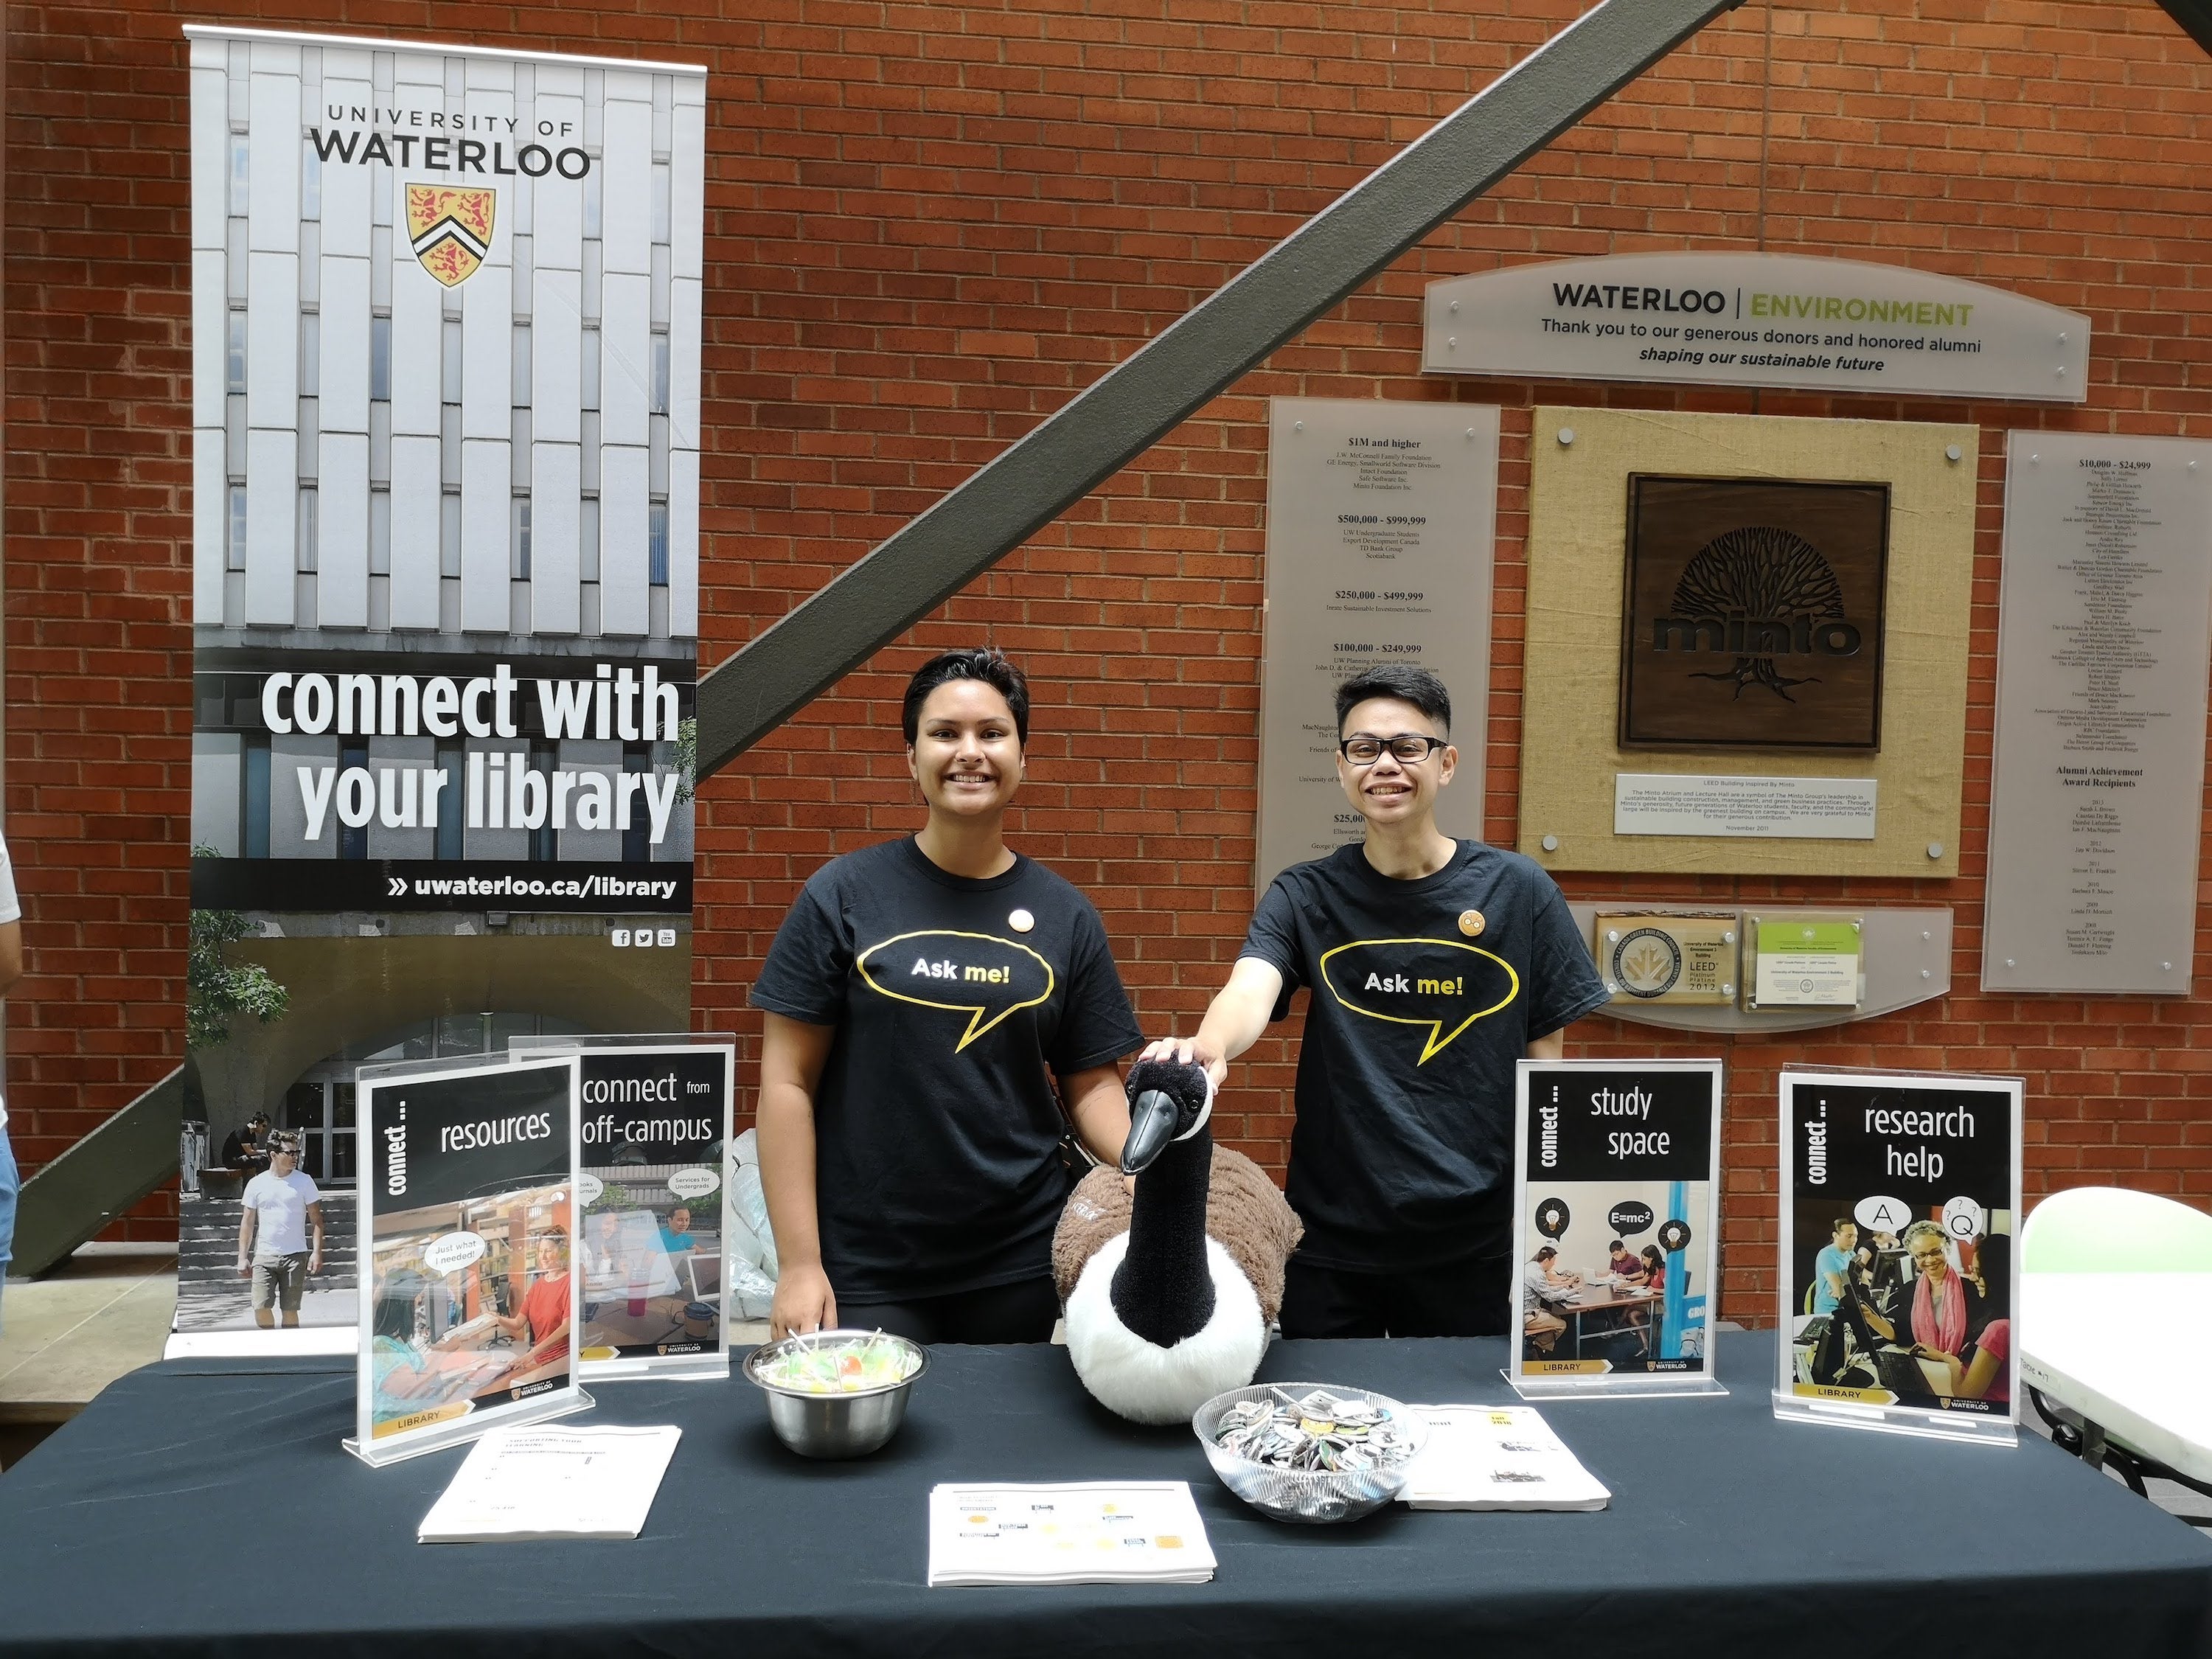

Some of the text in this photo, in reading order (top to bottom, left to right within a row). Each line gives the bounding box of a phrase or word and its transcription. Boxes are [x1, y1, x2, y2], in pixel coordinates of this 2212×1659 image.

[328, 105, 573, 137] UNIVERSITY OF
[310, 128, 590, 180] WATERLOO
[1552, 283, 1974, 327] WATERLOO ENVIRONMENT
[1541, 318, 1981, 352] Thank you to our generous donors and honored alumni
[1639, 348, 1885, 371] shaping our sustainable future
[1349, 437, 1421, 450] $1M and higher
[2079, 459, 2111, 468] $10,000
[2119, 461, 2151, 470] $24,999
[1338, 515, 1377, 524] $500,000
[1386, 516, 1426, 525] $999,999
[1335, 591, 1375, 600] $250,000
[1383, 591, 1424, 601] $499,999
[1653, 610, 1861, 655] minto
[1333, 643, 1374, 653] $100,000
[1382, 644, 1422, 653] $249,999
[262, 664, 679, 742] connect with
[2056, 767, 2143, 776] Alumni Achievement
[2062, 779, 2136, 788] Award Recipients
[297, 751, 678, 844] your library
[1334, 814, 1366, 824] $25,00
[414, 875, 677, 900] uwaterloo.ca/library
[911, 958, 1010, 984] Ask me!
[1364, 972, 1463, 995] Ask me!
[582, 1073, 710, 1104] connect from
[1590, 1086, 1652, 1120] study
[441, 1112, 552, 1153] resources
[582, 1114, 712, 1145] off-campus
[1865, 1106, 1975, 1138] research
[1608, 1131, 1670, 1160] space
[1887, 1144, 1944, 1183] help
[1873, 1203, 1893, 1225] A
[1951, 1214, 1973, 1236] Q
[436, 1240, 476, 1254] Just what
[441, 1251, 475, 1264] needed!
[1543, 1363, 1582, 1371] LIBRARY
[521, 1382, 553, 1396] WATERLOO
[1818, 1387, 1861, 1399] LIBRARY
[1951, 1402, 1989, 1411] WATERLOO
[398, 1411, 440, 1429] LIBRARY
